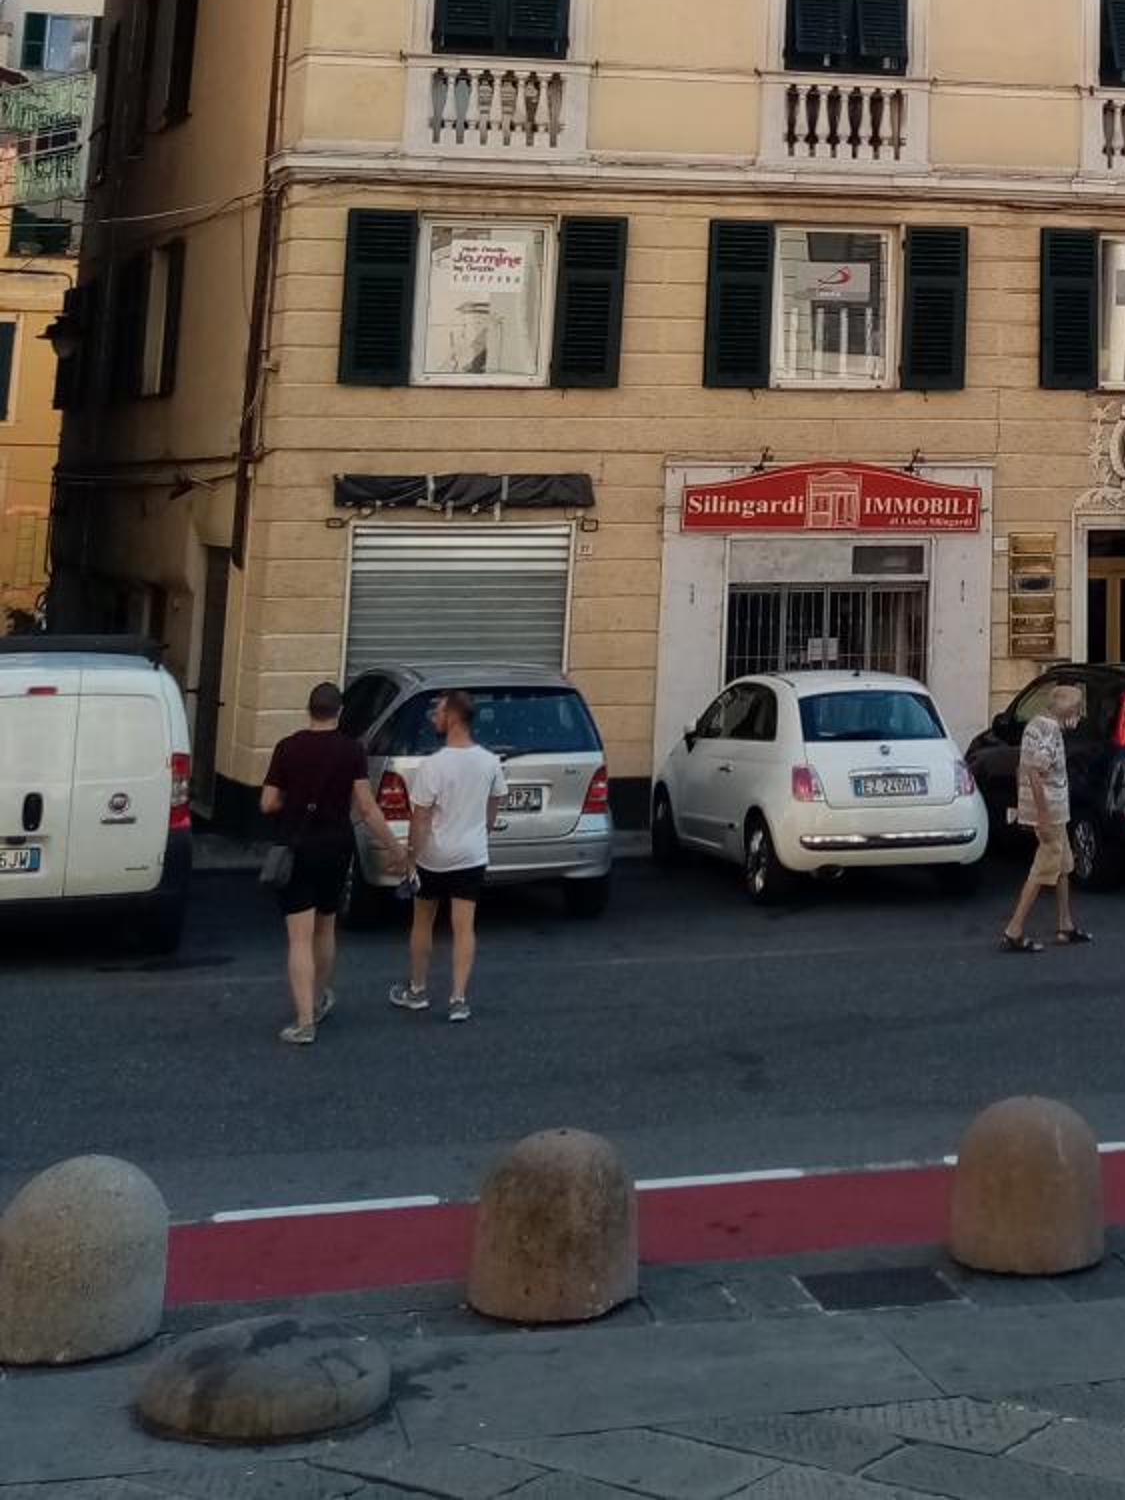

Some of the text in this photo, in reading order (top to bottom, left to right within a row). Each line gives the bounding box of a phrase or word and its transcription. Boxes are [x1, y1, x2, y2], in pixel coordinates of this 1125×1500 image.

[452, 253, 522, 268] Jasmine
[687, 495, 973, 518] Silingardi IMMOBILI
